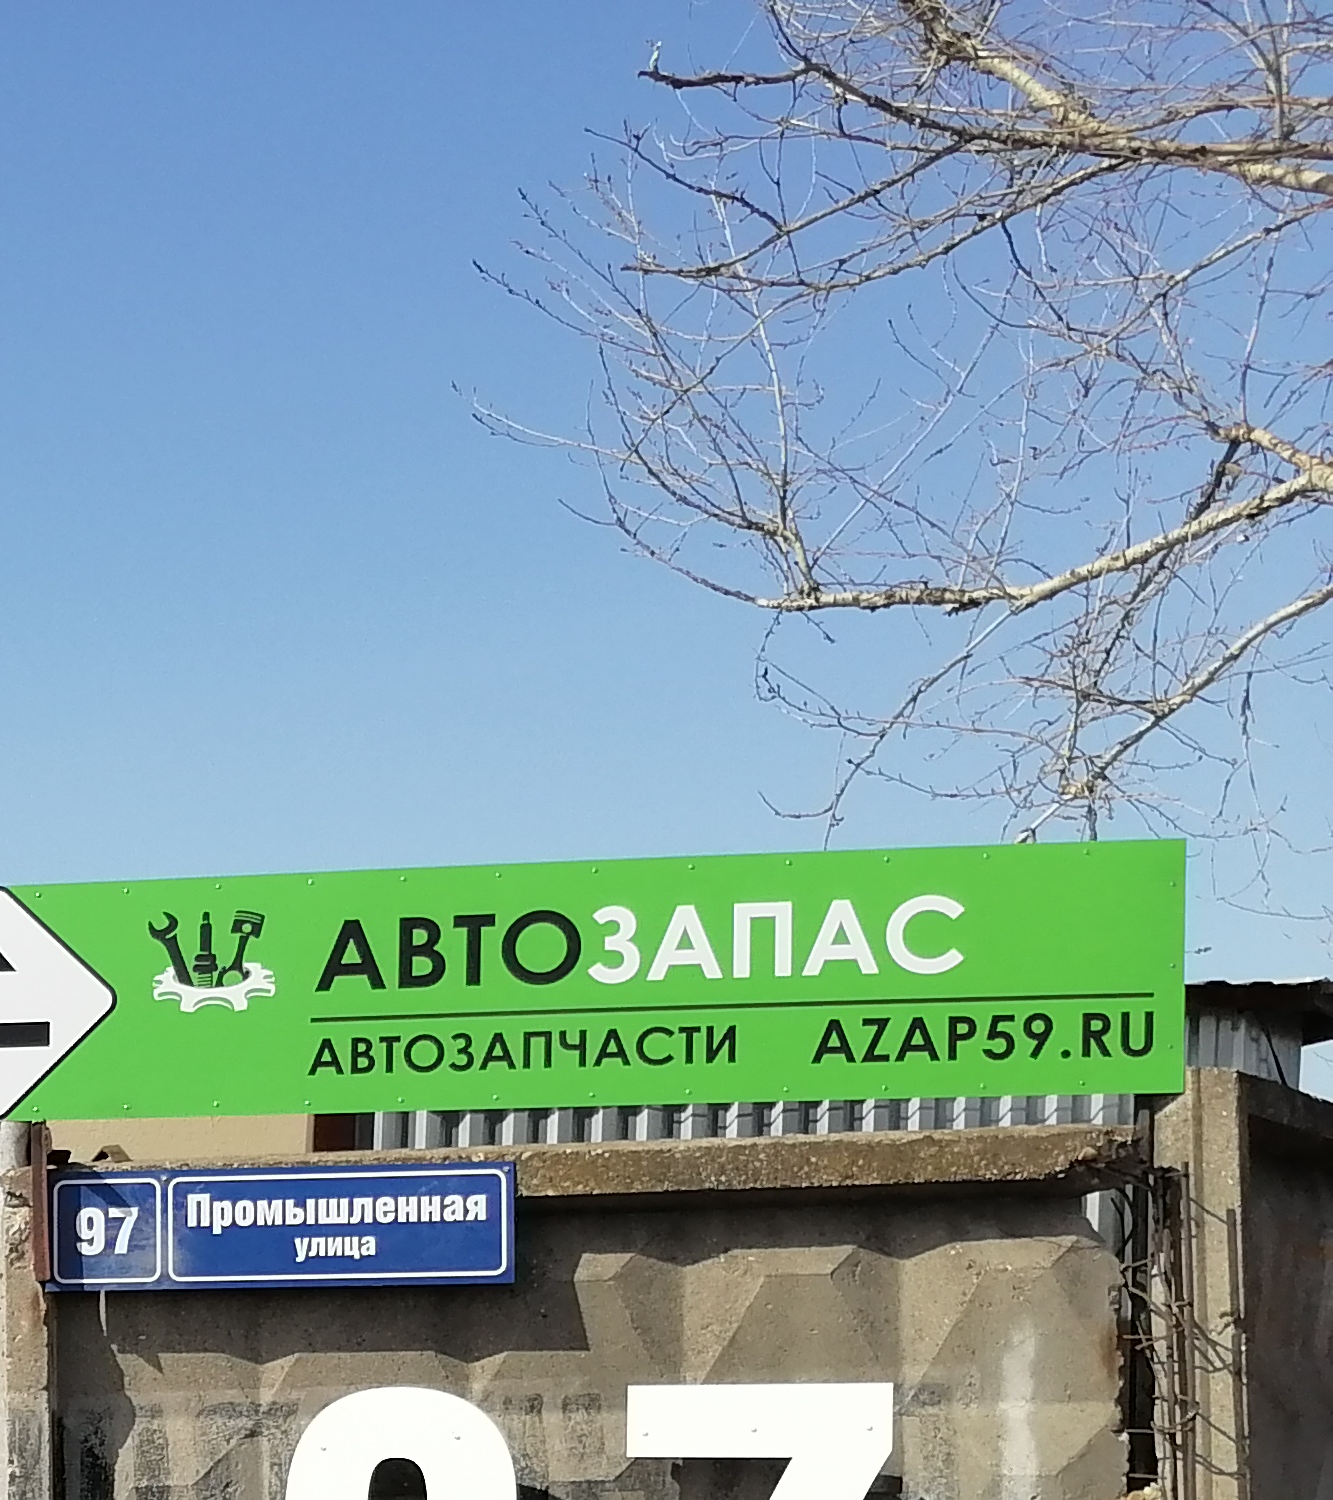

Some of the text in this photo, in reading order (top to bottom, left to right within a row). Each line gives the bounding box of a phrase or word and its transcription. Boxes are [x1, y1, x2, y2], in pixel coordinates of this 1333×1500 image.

[315, 894, 965, 992] АВТОЗАПАС
[308, 1024, 737, 1076] АВТОЗАПЧАСТИ
[811, 1010, 1155, 1064] AZAP59.RU
[75, 1206, 139, 1256] 97
[186, 1193, 488, 1234] Промышленная
[293, 1235, 377, 1262] улица
